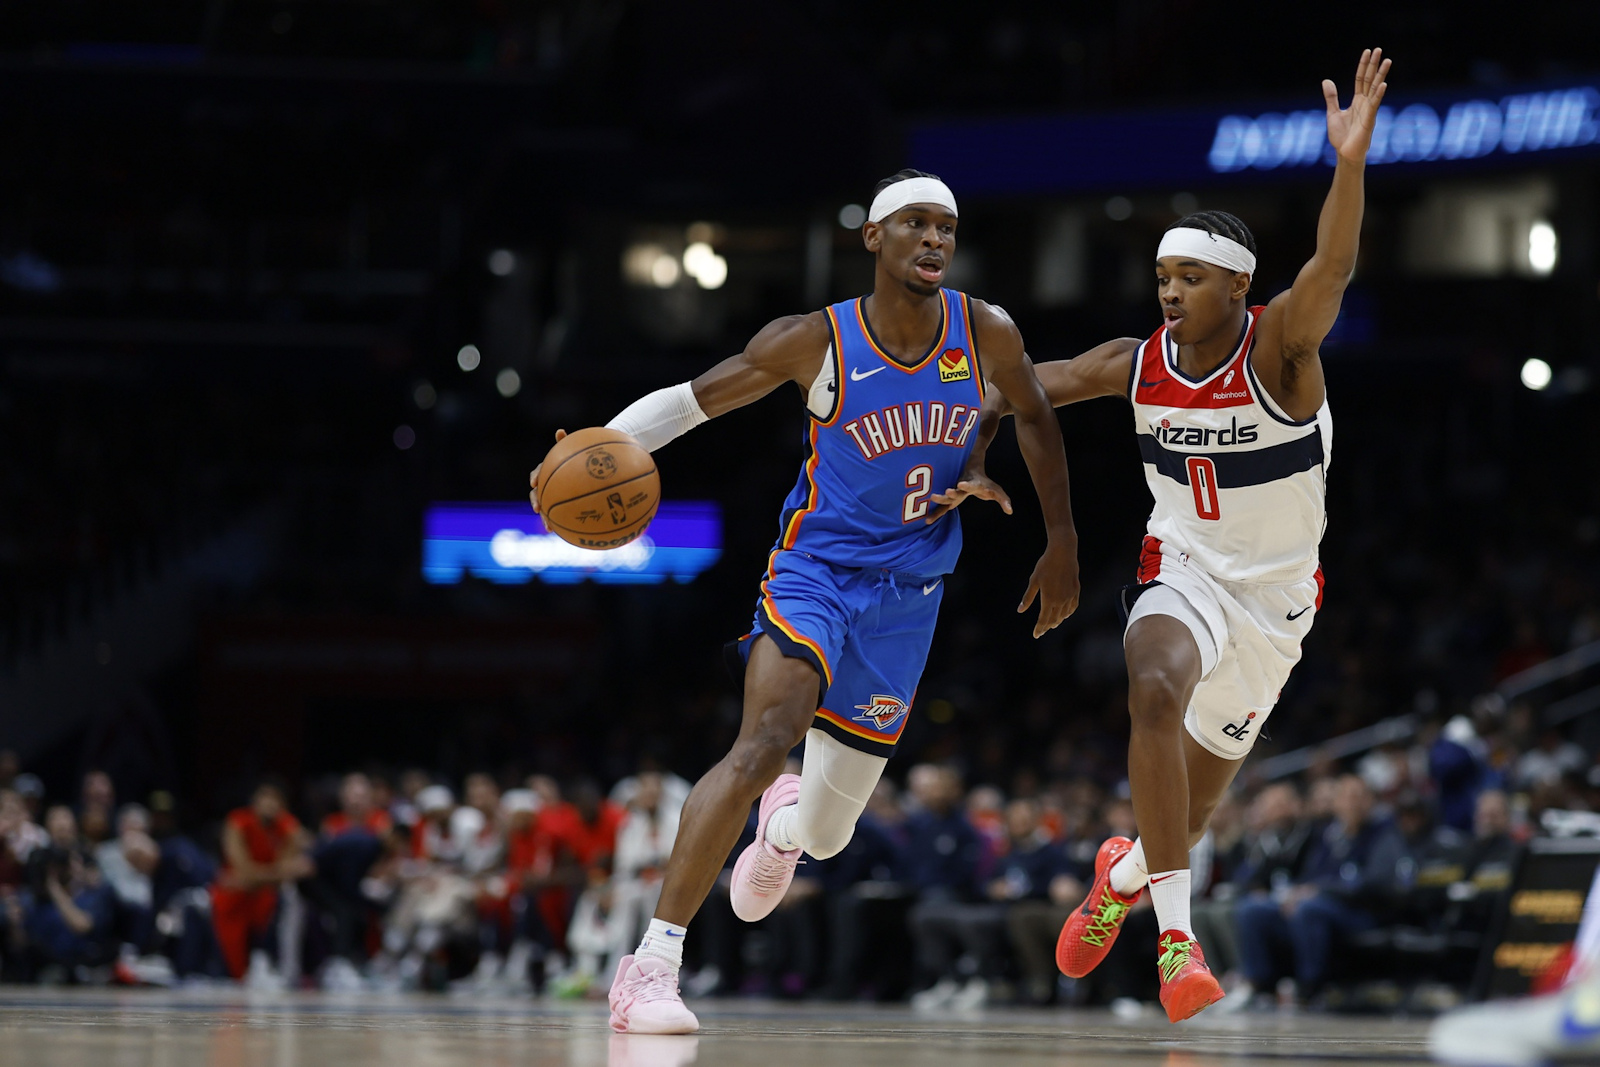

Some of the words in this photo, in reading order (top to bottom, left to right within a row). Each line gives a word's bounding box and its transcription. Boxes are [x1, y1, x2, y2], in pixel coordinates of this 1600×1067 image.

[1212, 390, 1247, 400] Robinhood
[843, 402, 980, 461] THUNDER
[902, 463, 933, 524] 2
[1185, 456, 1221, 521] 0
[863, 704, 898, 717] OKC
